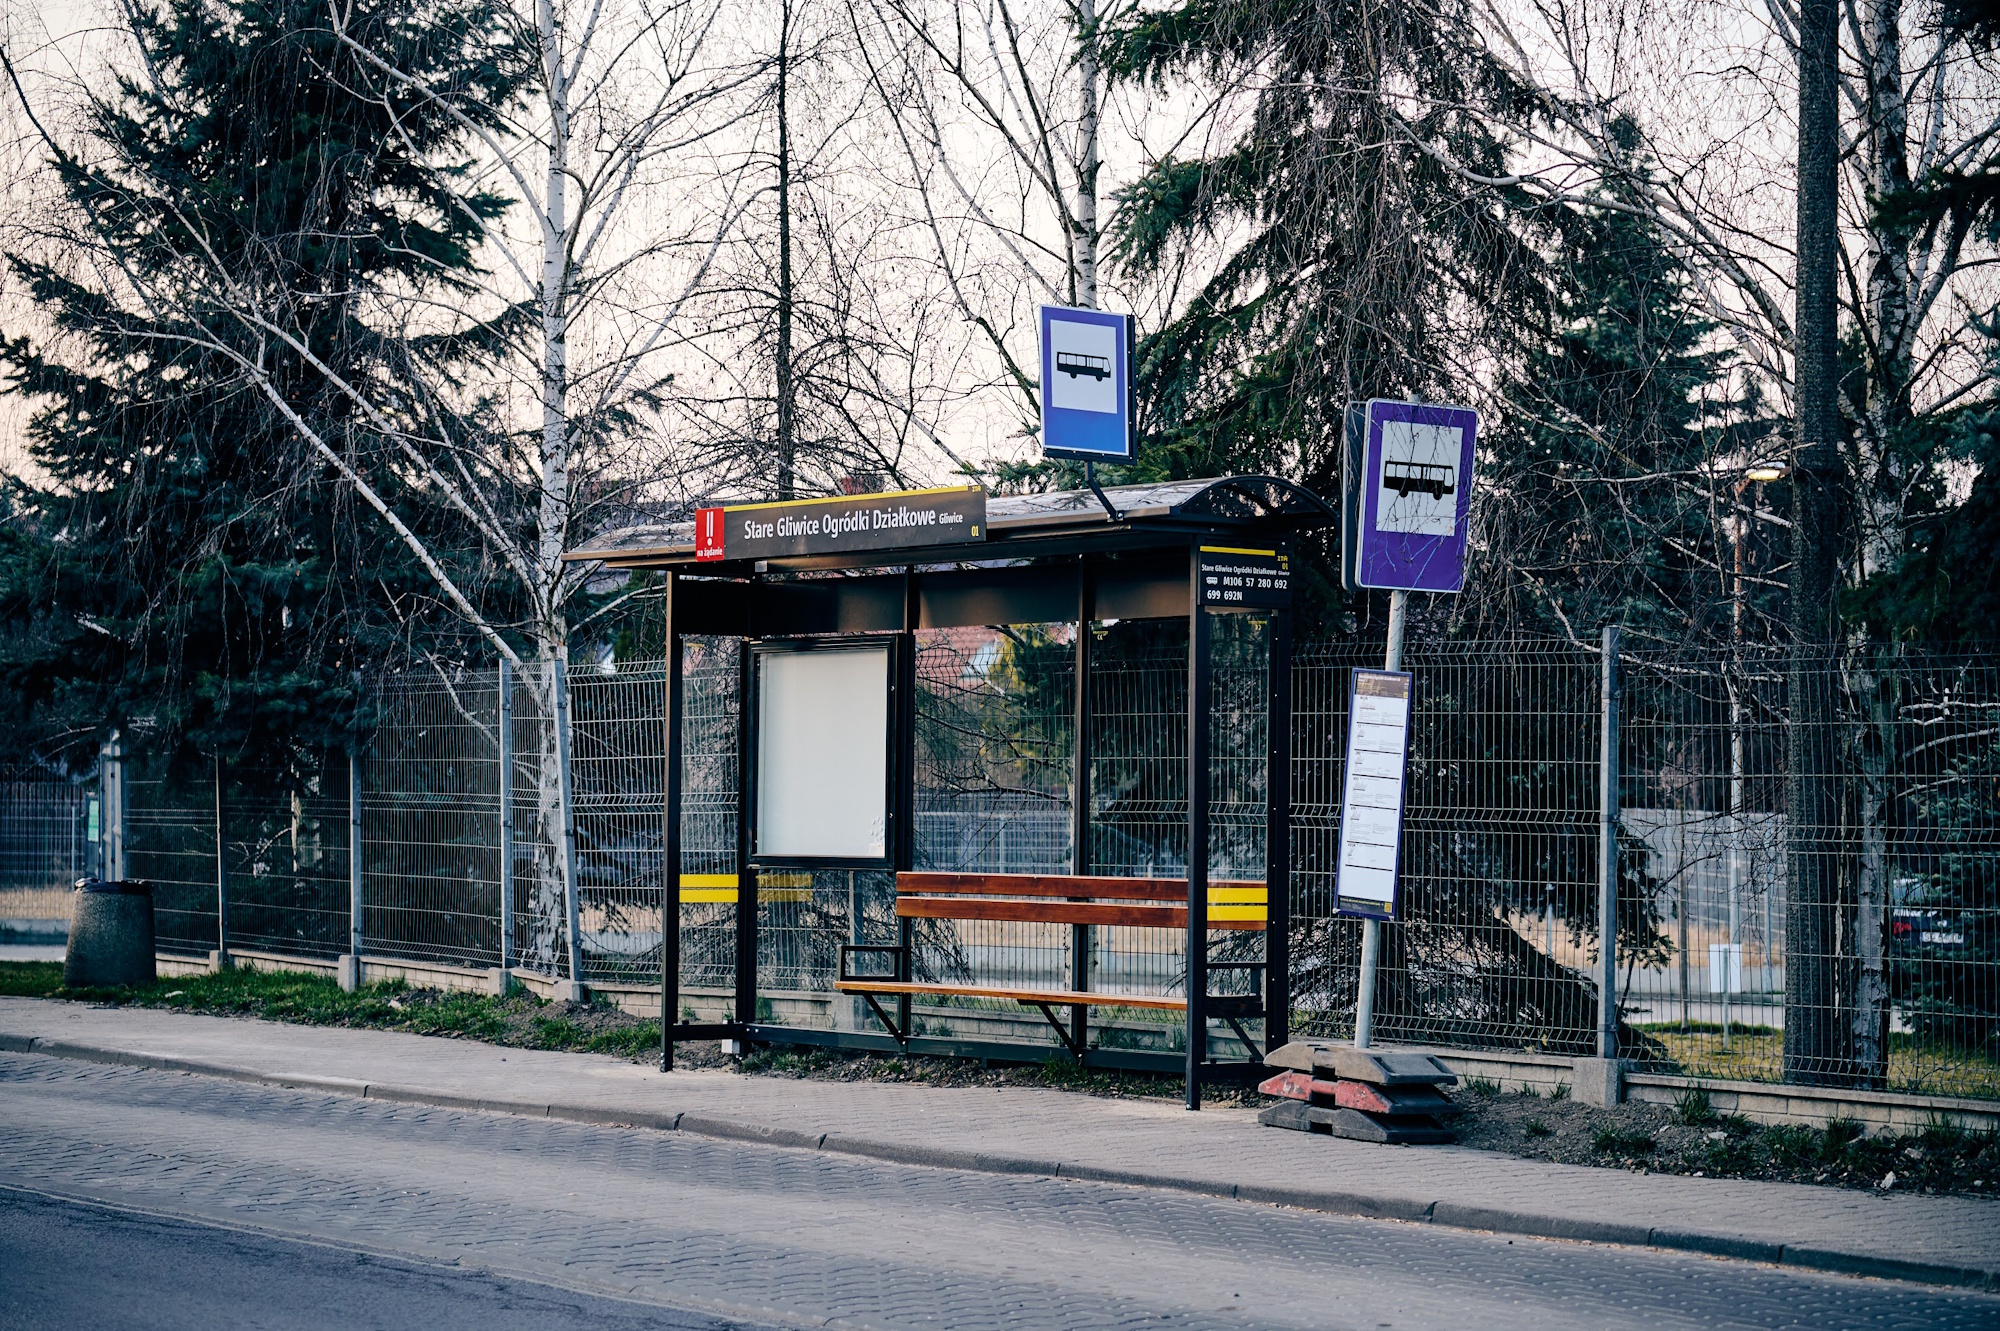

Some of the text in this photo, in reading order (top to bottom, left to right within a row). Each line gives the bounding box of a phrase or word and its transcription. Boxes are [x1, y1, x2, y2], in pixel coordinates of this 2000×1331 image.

[744, 506, 963, 540] Stare Gliwice Ogródki Działkowe Gliwice
[971, 525, 979, 537] 01
[696, 546, 723, 558] na żądanie
[1201, 563, 1214, 572] Stare
[1215, 564, 1233, 573] Gliwice
[1233, 565, 1252, 575] Ogródki
[1253, 567, 1277, 576] Działkowe
[1223, 576, 1287, 589] M106 57 280 692
[1207, 590, 1243, 601] 699 692N
